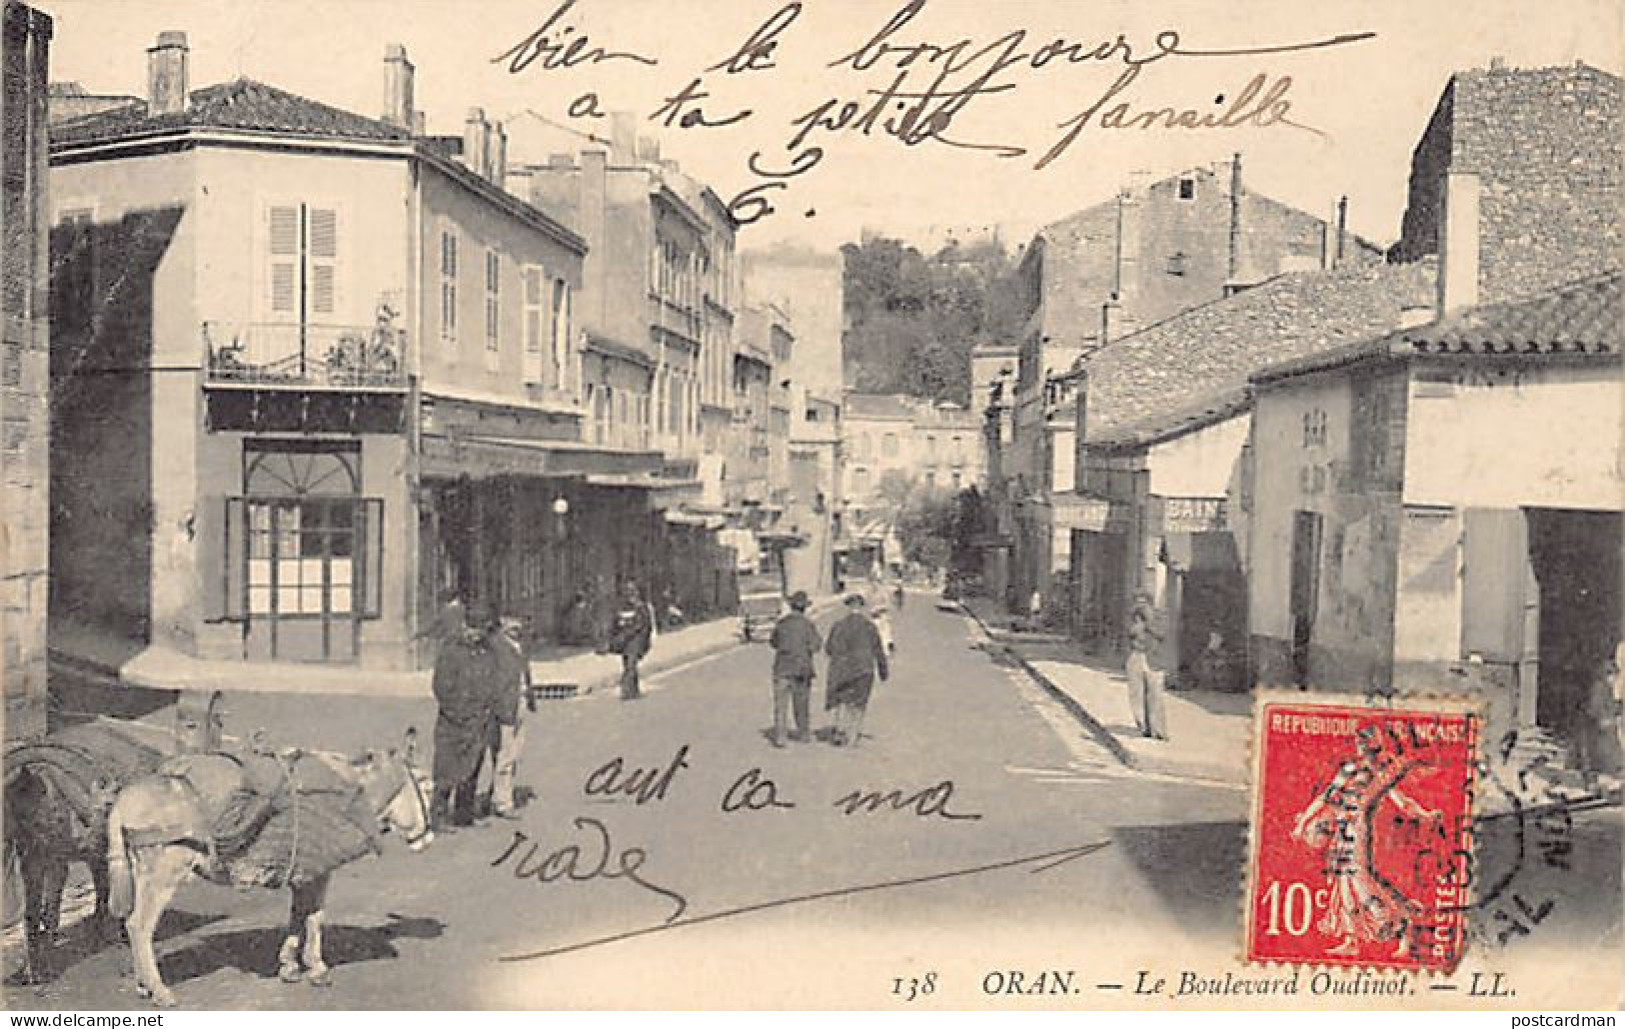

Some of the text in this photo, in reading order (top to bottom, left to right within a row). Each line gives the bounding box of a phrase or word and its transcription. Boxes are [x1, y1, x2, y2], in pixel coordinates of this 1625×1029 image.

[490, 0, 658, 74] bien
[704, 2, 803, 75] le
[648, 78, 754, 129] ta
